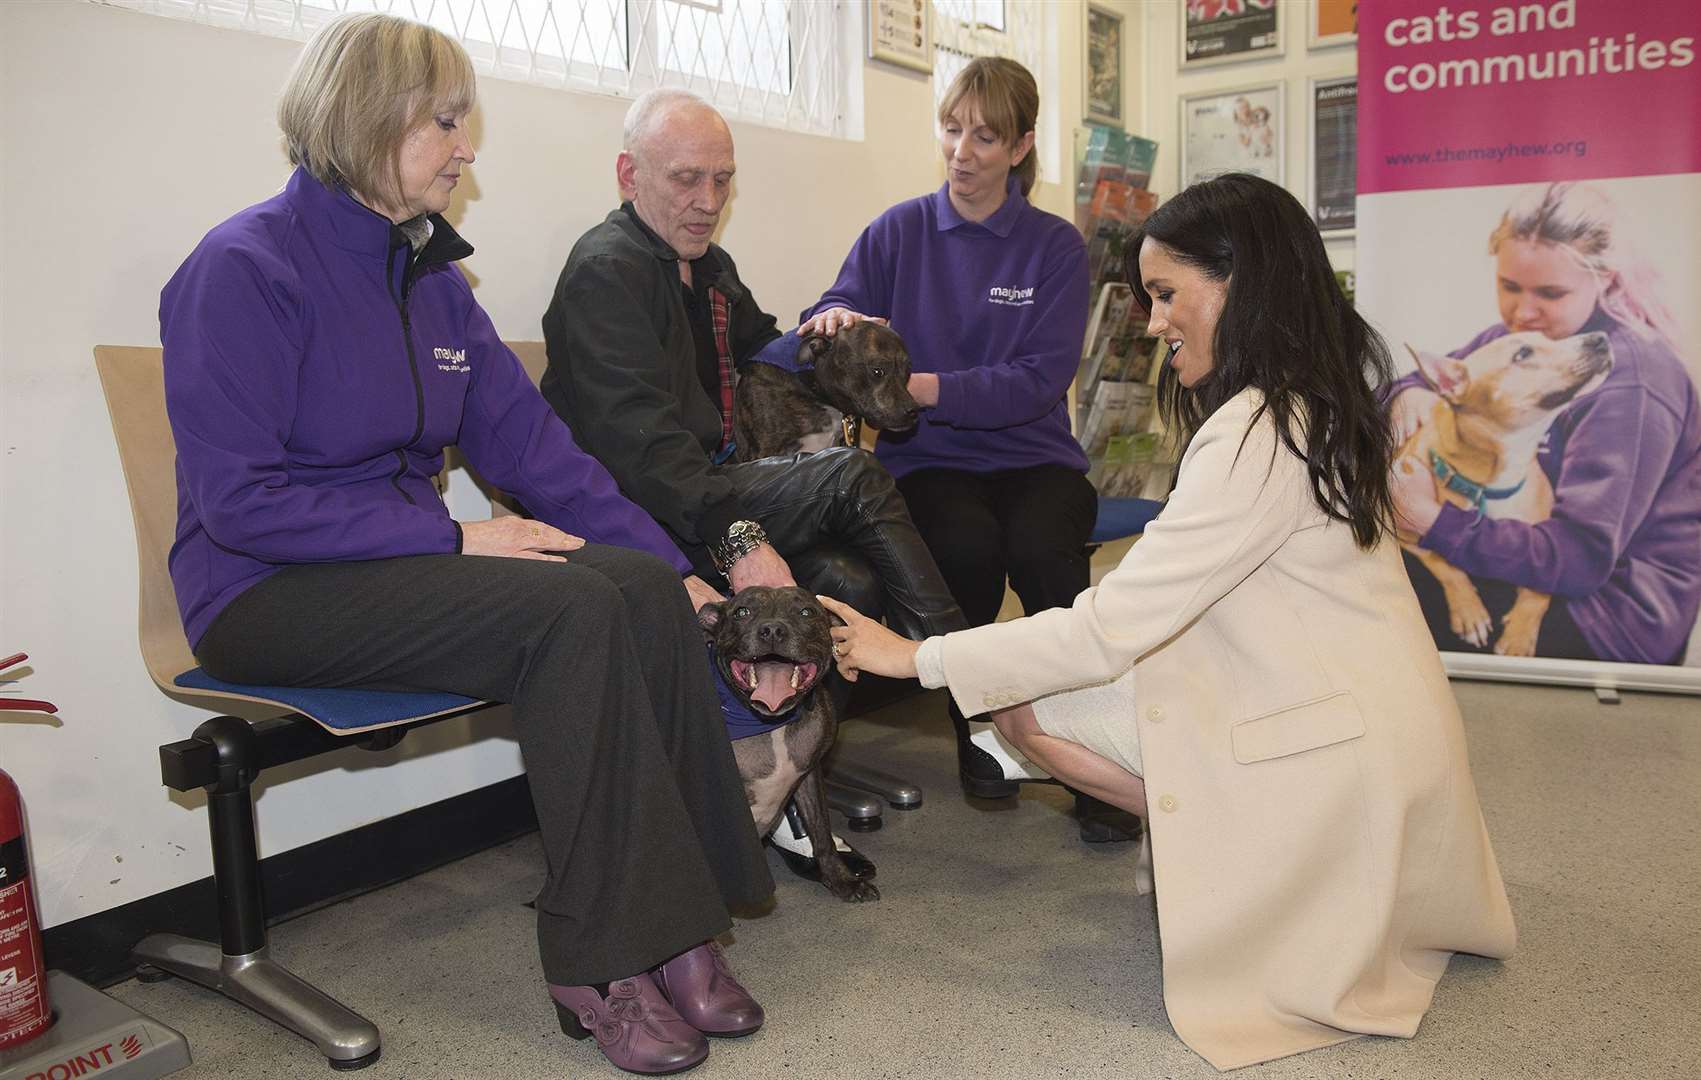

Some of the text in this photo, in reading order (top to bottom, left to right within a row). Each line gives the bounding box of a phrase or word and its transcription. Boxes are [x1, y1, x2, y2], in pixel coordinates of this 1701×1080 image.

[1384, 0, 1577, 46] cats and
[1384, 33, 1696, 94] communities
[1385, 139, 1588, 166] www.themayhew.org
[990, 285, 1034, 301] mayhew
